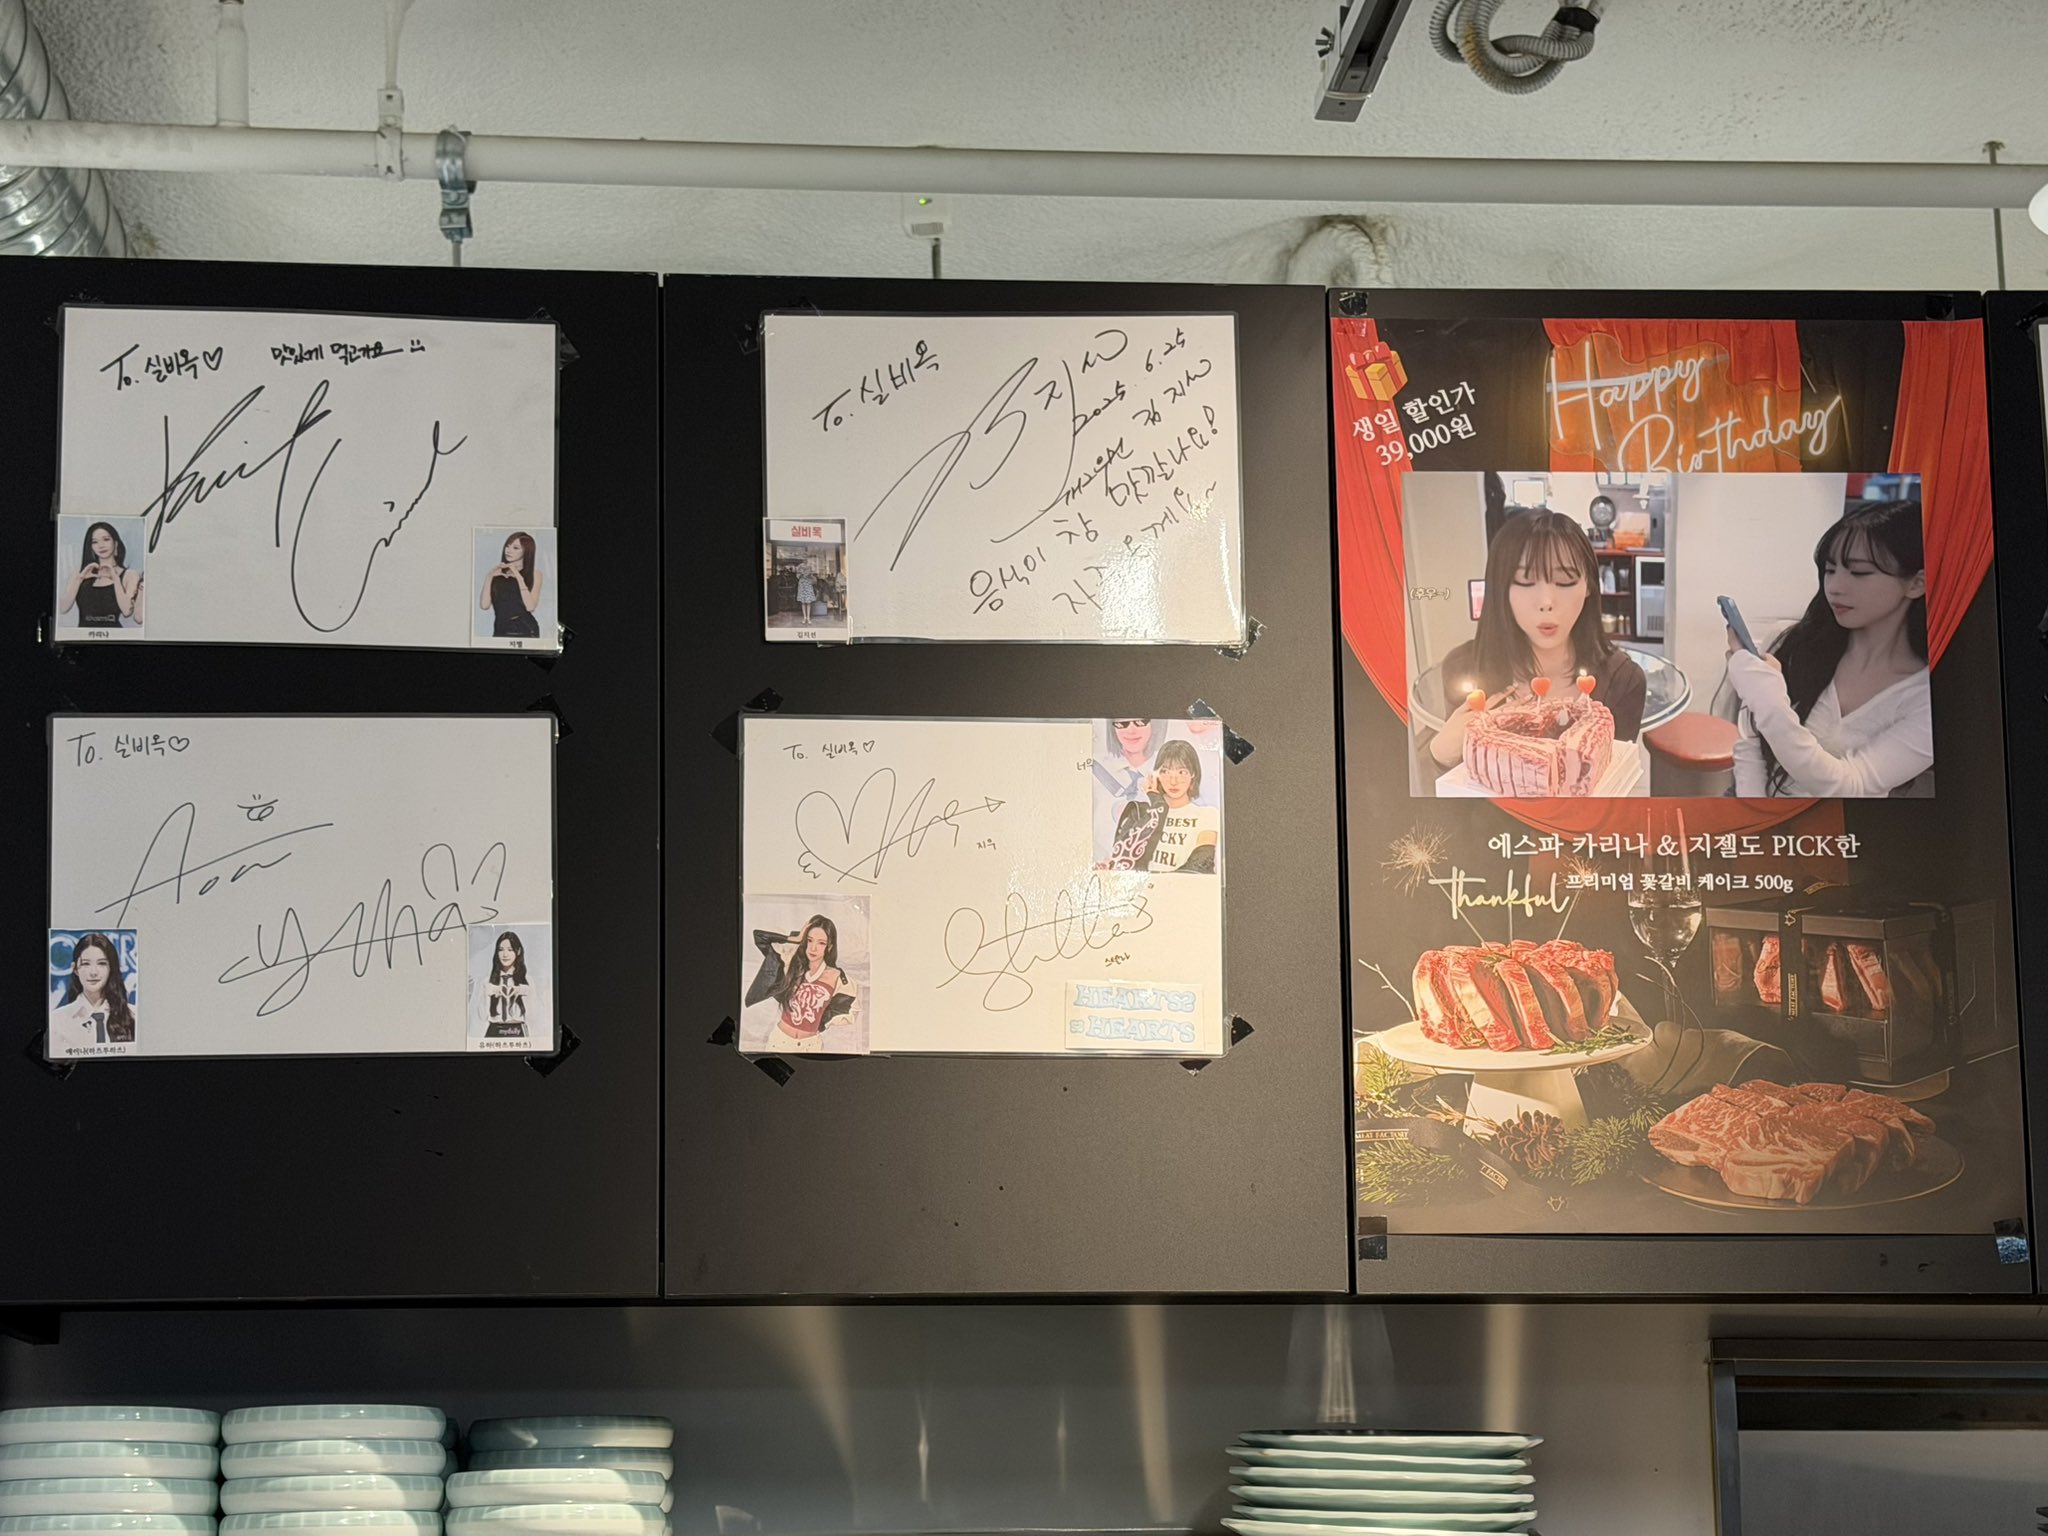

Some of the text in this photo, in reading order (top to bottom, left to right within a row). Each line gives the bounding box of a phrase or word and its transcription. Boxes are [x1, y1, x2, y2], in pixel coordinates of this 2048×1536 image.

[99, 344, 199, 390] To. 실비옥
[812, 339, 939, 432] To. 실비옥
[1547, 340, 1704, 450] Happy
[1353, 381, 1476, 442] 생일 할인가
[1376, 413, 1477, 467] 39,000원
[1617, 395, 1842, 473] Birthday
[791, 526, 823, 539] 실비옥
[67, 732, 166, 767] To. 실비옥
[783, 741, 858, 760] To. 실비옥
[1166, 817, 1198, 828] BEST
[1154, 851, 1177, 867] IRL
[1487, 833, 1861, 859] 에스파 카리나 & 지젤도 PICK한
[1565, 873, 1634, 891] 프리미엄
[1639, 873, 1692, 892] 꽃갈비
[1698, 873, 1749, 891] 케이크
[1755, 875, 1794, 893] 500g
